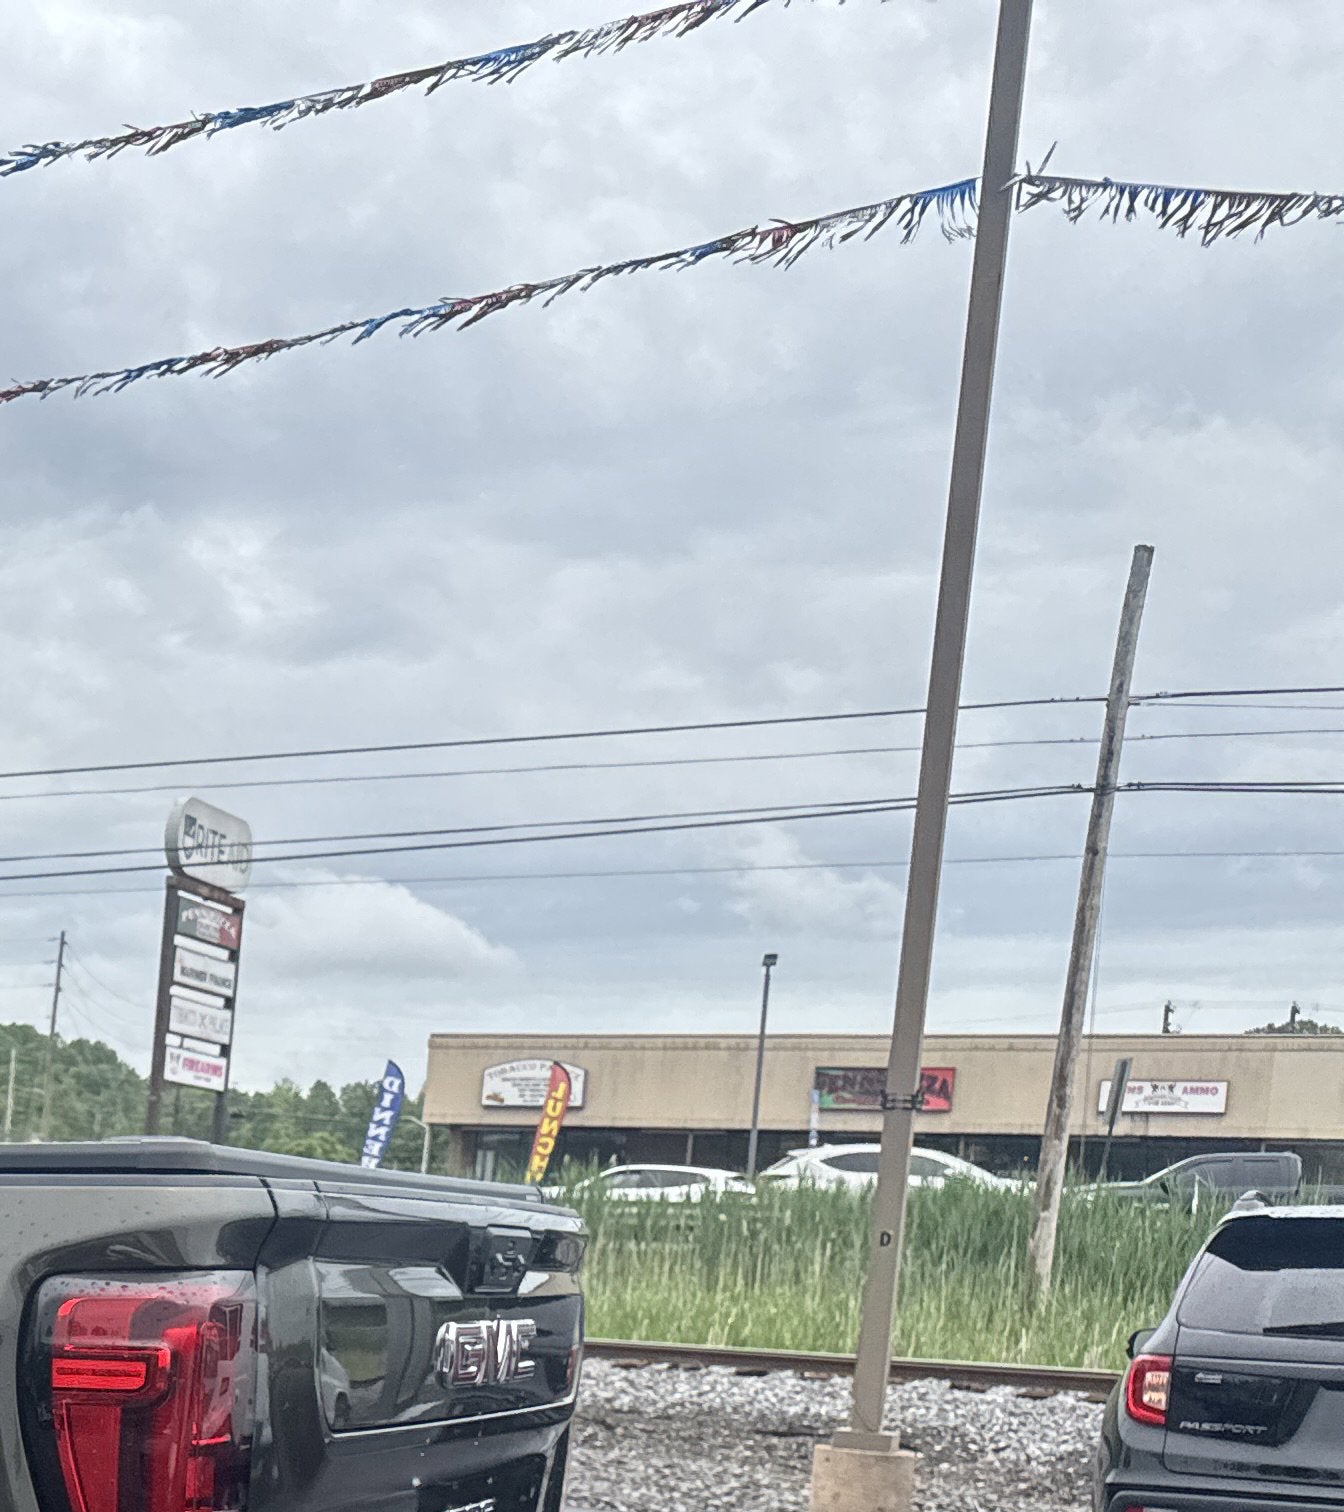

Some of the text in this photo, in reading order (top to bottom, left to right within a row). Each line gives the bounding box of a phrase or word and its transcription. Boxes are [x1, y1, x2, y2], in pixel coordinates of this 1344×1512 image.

[197, 823, 227, 864] RITE
[1182, 1086, 1220, 1096] AMMO
[434, 1317, 537, 1388] GMC
[1179, 1420, 1268, 1435] PASSPORT
